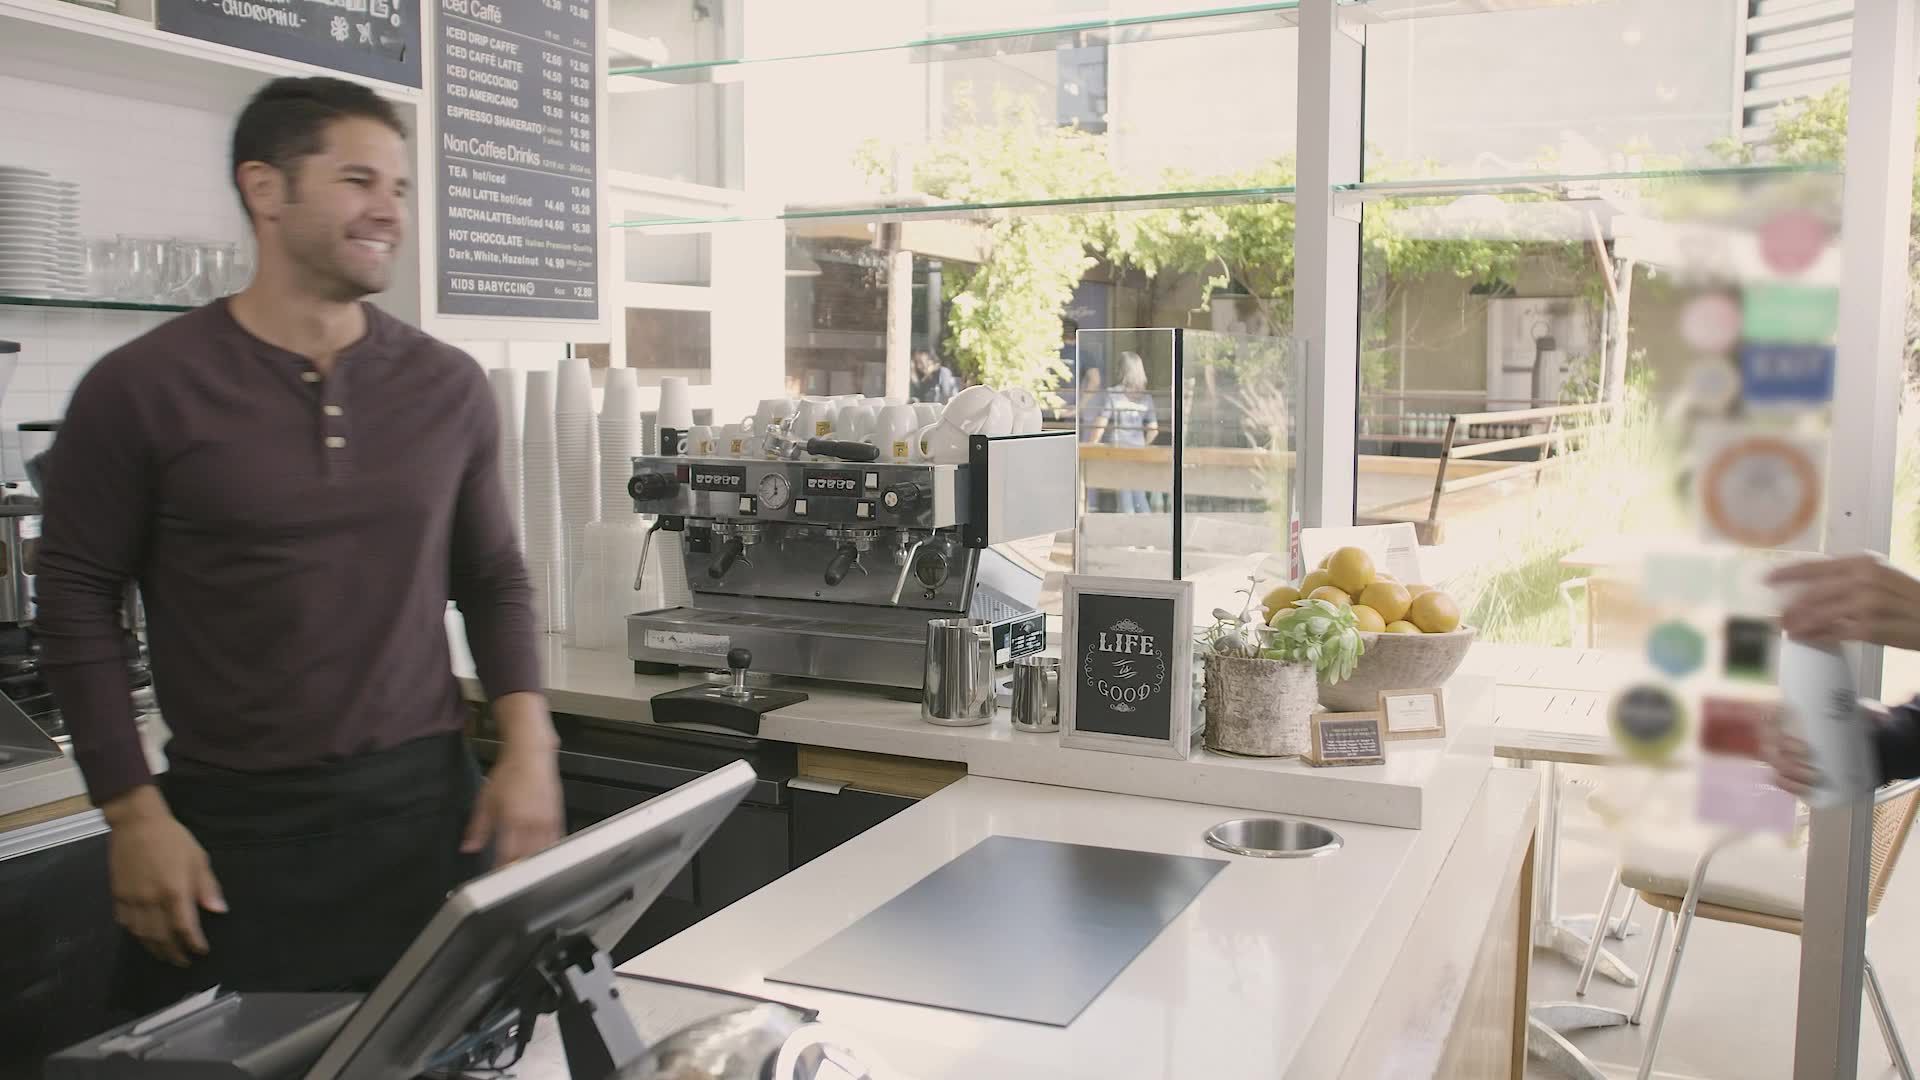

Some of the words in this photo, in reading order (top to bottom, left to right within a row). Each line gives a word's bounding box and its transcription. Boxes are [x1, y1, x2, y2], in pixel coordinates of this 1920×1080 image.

[446, 25, 467, 41] ICED
[468, 32, 488, 46] DRIP
[446, 44, 467, 59] ICED
[498, 57, 524, 73] LATTE
[446, 64, 468, 78] ICED
[469, 70, 518, 90] CHOCOCINO
[446, 83, 468, 97] ICED
[468, 88, 518, 108] AMERICANO
[447, 104, 492, 124] ESPRESSO
[494, 115, 542, 134] SHAKERATO
[444, 133, 468, 154] Non
[469, 138, 506, 160] Coffee
[507, 145, 540, 166] Drinks
[448, 165, 468, 178] TEA
[472, 168, 506, 184] hot/iced
[448, 185, 470, 198] CHAI
[472, 188, 500, 202] LATTE
[500, 192, 533, 208] hot/iced
[448, 207, 486, 221] MATCHA
[486, 211, 512, 224] LATTE
[512, 214, 544, 228] hot/iced
[448, 229, 468, 240] HOT
[470, 231, 523, 247] CHOCOLATE
[502, 254, 539, 266] Hazelnut
[545, 257, 565, 269] $4.90
[450, 278, 474, 290] KIDS
[574, 287, 592, 297] $2.80
[1098, 632, 1154, 656] LIFE
[1119, 664, 1131, 674] is
[1098, 680, 1150, 702] GOOD
